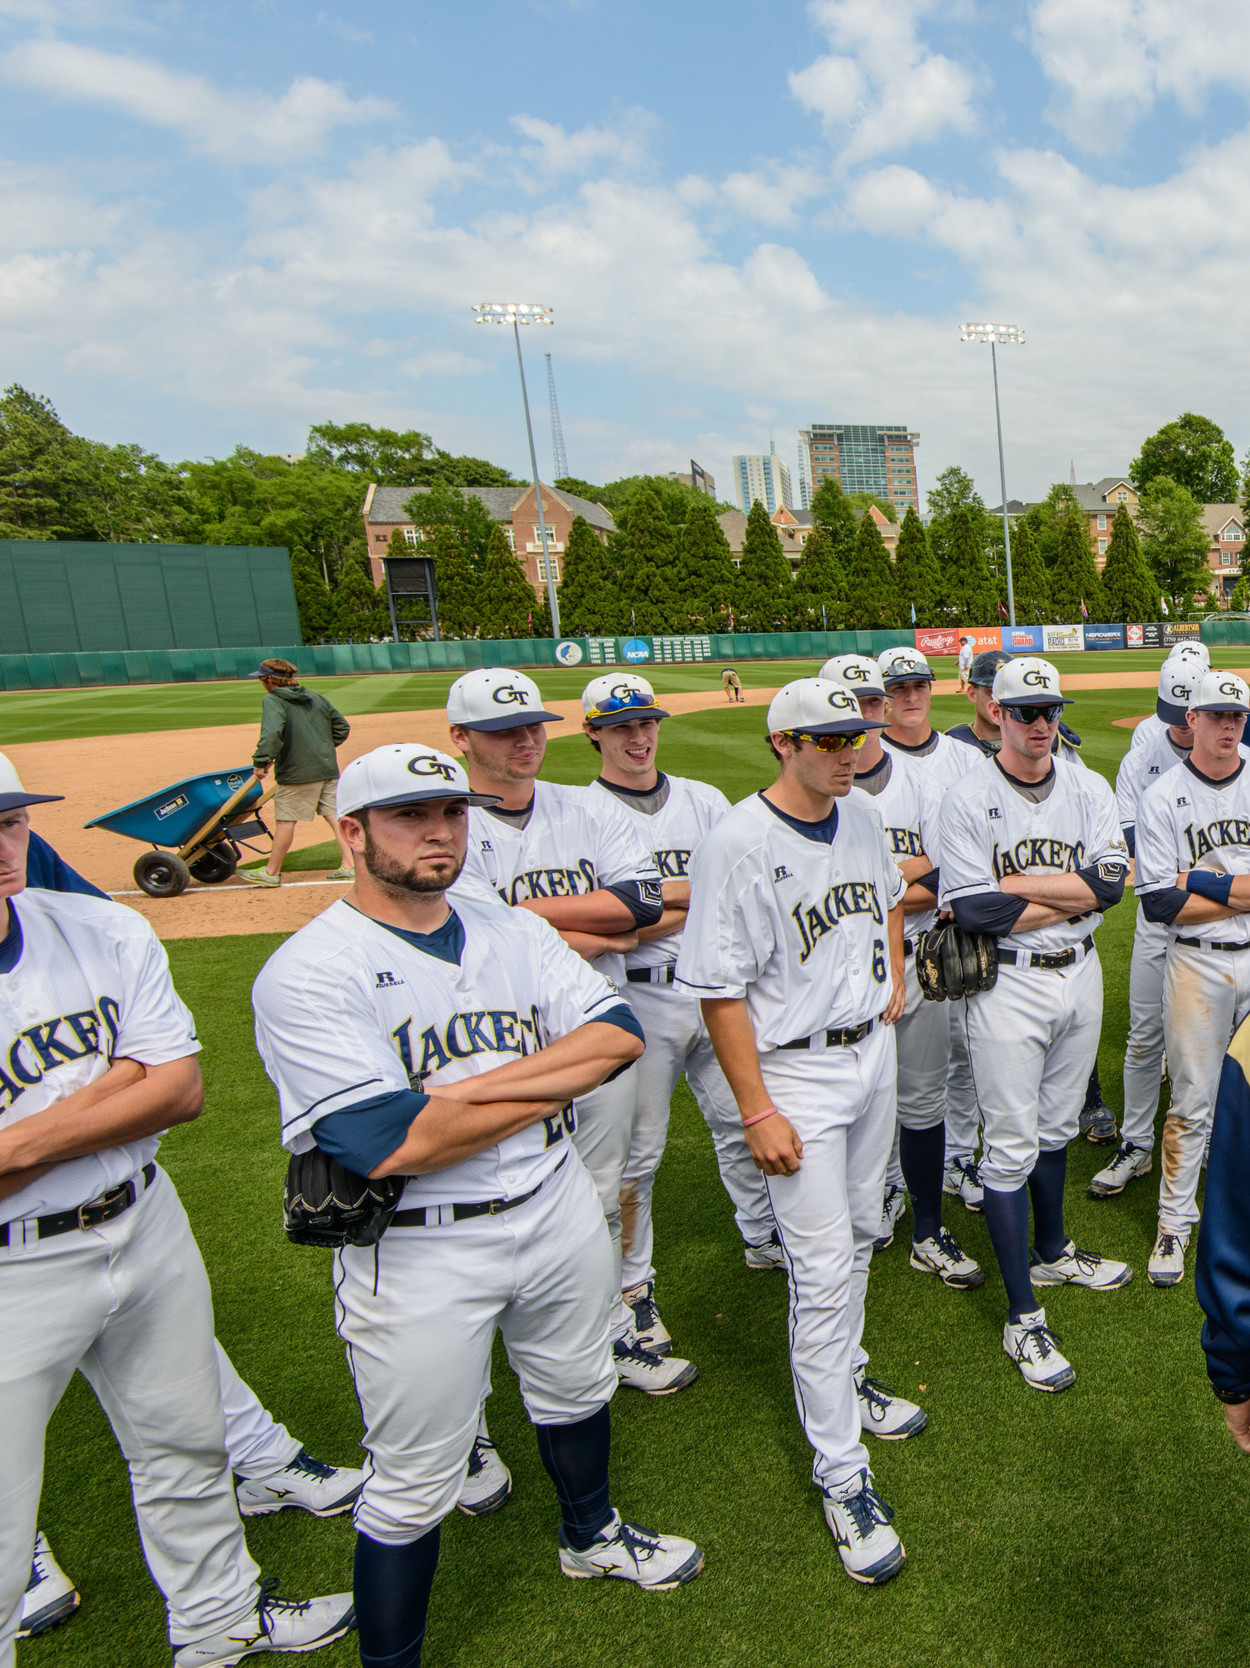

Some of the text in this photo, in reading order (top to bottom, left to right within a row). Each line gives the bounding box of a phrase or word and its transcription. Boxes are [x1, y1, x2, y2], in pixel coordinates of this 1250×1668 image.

[920, 633, 955, 649] Rawlings
[977, 636, 998, 646] at&t
[1012, 638, 1033, 646] GUARD
[627, 651, 648, 659] NCAA
[842, 664, 871, 682] GT
[1023, 670, 1051, 689] GT
[492, 684, 529, 706] GT
[1171, 684, 1192, 700] GT
[1219, 682, 1243, 700] GT
[827, 690, 858, 712] GT
[407, 755, 457, 781] GT
[871, 938, 887, 986] 6
[376, 980, 406, 989] RUSSELL
